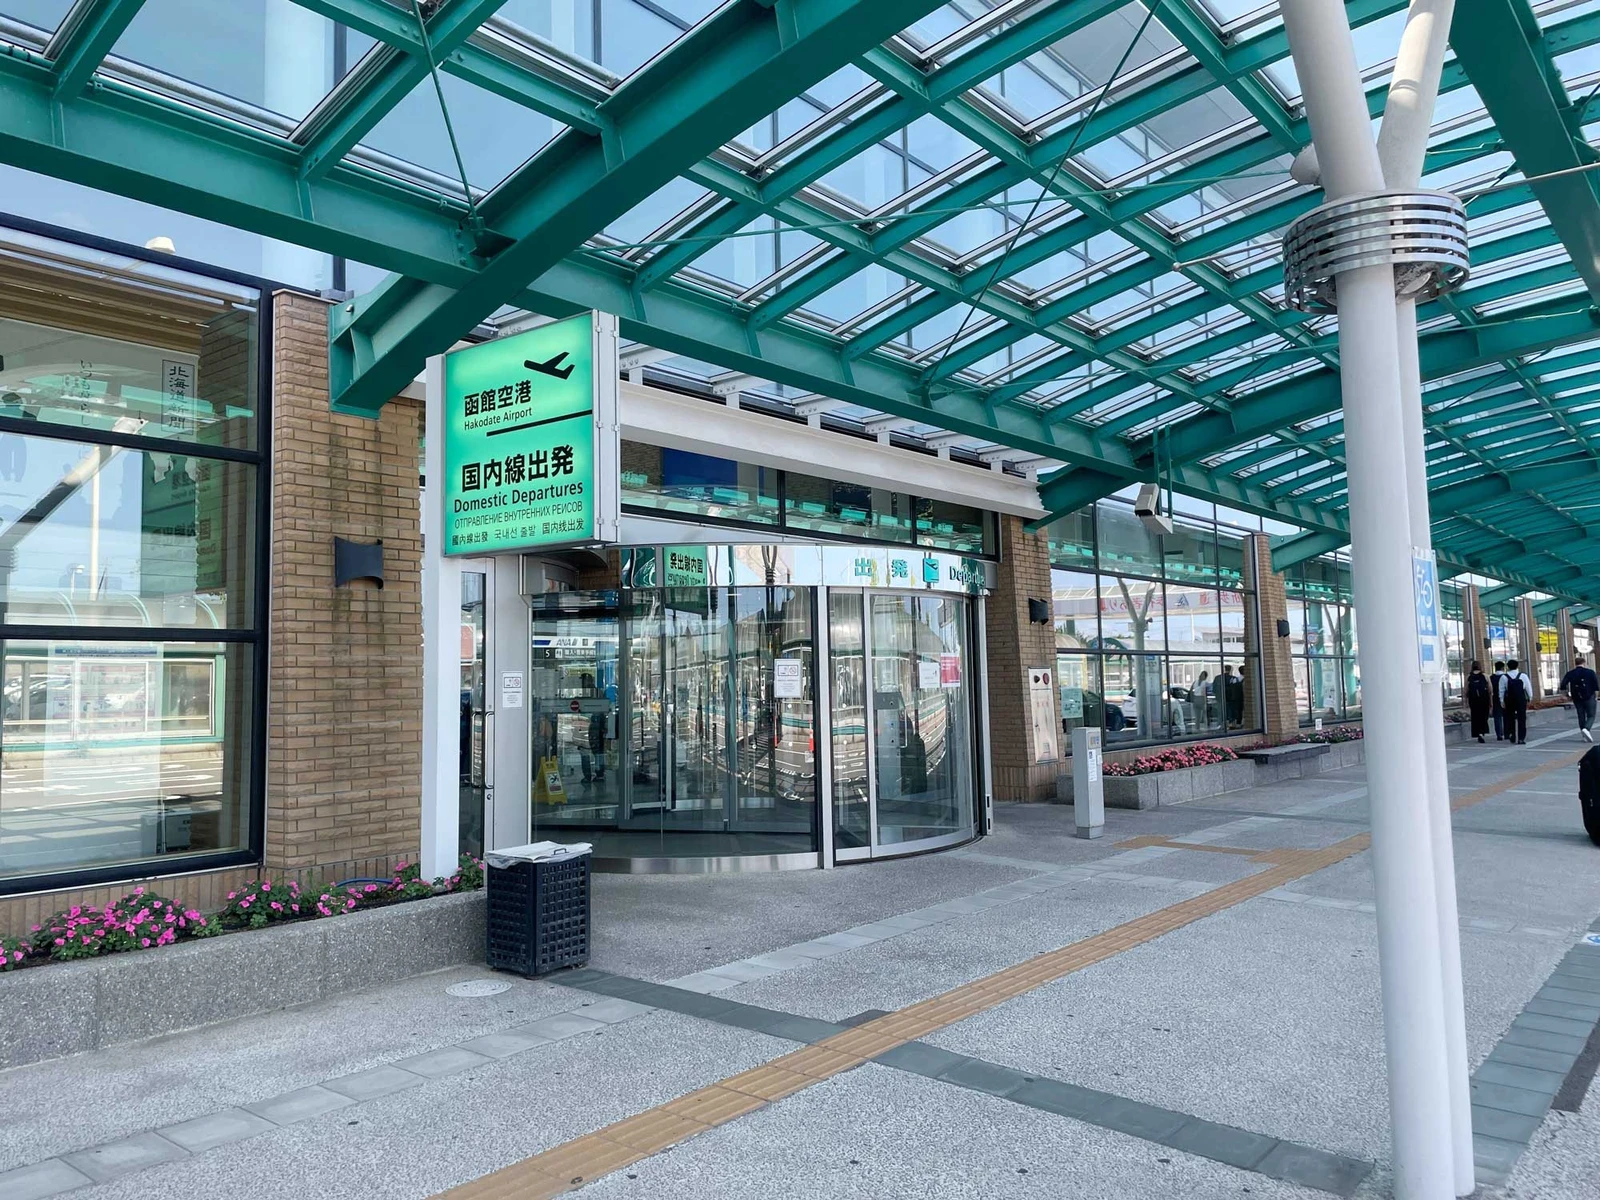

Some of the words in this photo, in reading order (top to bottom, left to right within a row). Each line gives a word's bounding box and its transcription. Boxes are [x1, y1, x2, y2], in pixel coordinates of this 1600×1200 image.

[464, 379, 531, 417] 函館空港
[464, 416, 501, 431] Hakodate
[503, 407, 532, 422] Airport
[462, 444, 574, 493] 国内線出発
[454, 491, 508, 513] Domestic
[512, 482, 583, 505] Departures
[454, 512, 503, 529] ОТПРАВЛЕНИЕ
[504, 504, 551, 522] ВНУТРЕННИХ
[542, 518, 584, 535] 国内线出发
[494, 527, 518, 540] 국내선
[520, 524, 536, 538] 출발
